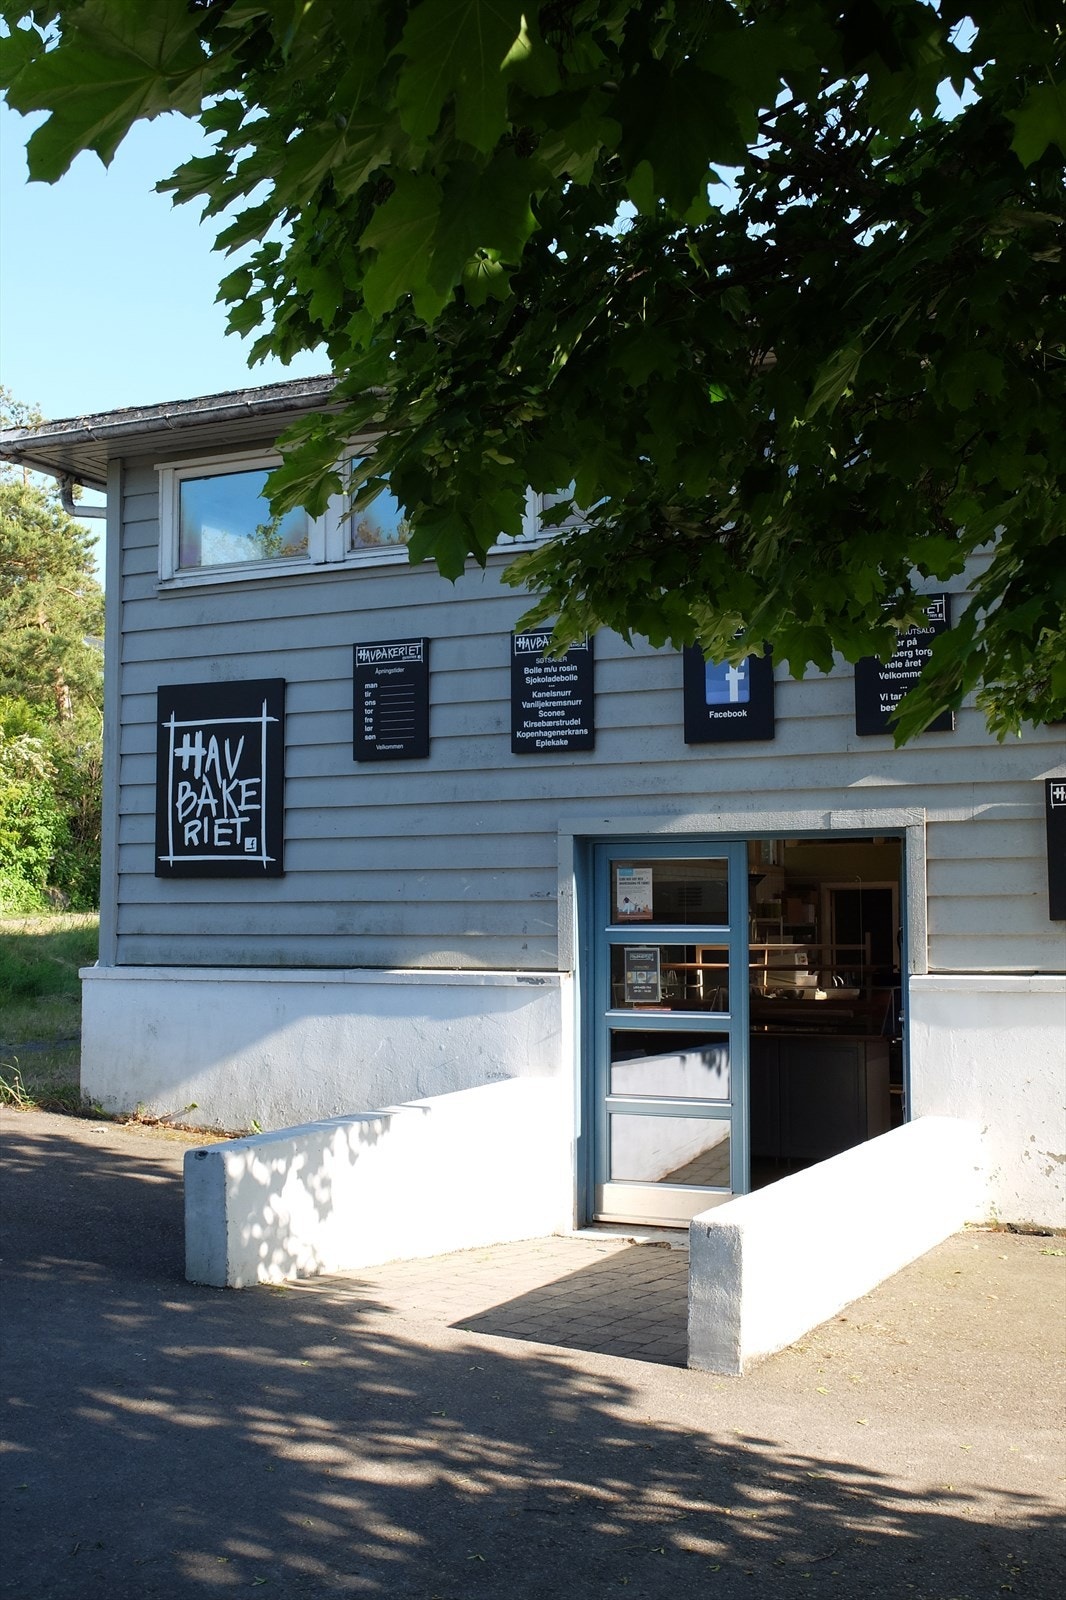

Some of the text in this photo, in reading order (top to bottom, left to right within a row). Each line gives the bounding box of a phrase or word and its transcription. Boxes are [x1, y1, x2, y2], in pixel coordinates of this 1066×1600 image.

[906, 637, 918, 647] på
[358, 645, 421, 662] HAVBAKERIET
[915, 648, 933, 656] torg
[904, 659, 922, 667] året
[559, 664, 578, 672] rosin
[525, 674, 578, 685] Sjokoladebolle
[878, 671, 923, 679] Velkomme
[532, 690, 572, 698] Kanelsnurr
[879, 693, 889, 701] Vi
[521, 699, 583, 709] Vaniljekremsnurr
[709, 709, 747, 718] Facebook
[516, 728, 589, 739] Kopenhagenerkrans
[535, 739, 569, 748] Eplekake
[173, 730, 245, 789] HAV
[175, 773, 261, 823] BAKE
[183, 816, 251, 847] RIET
